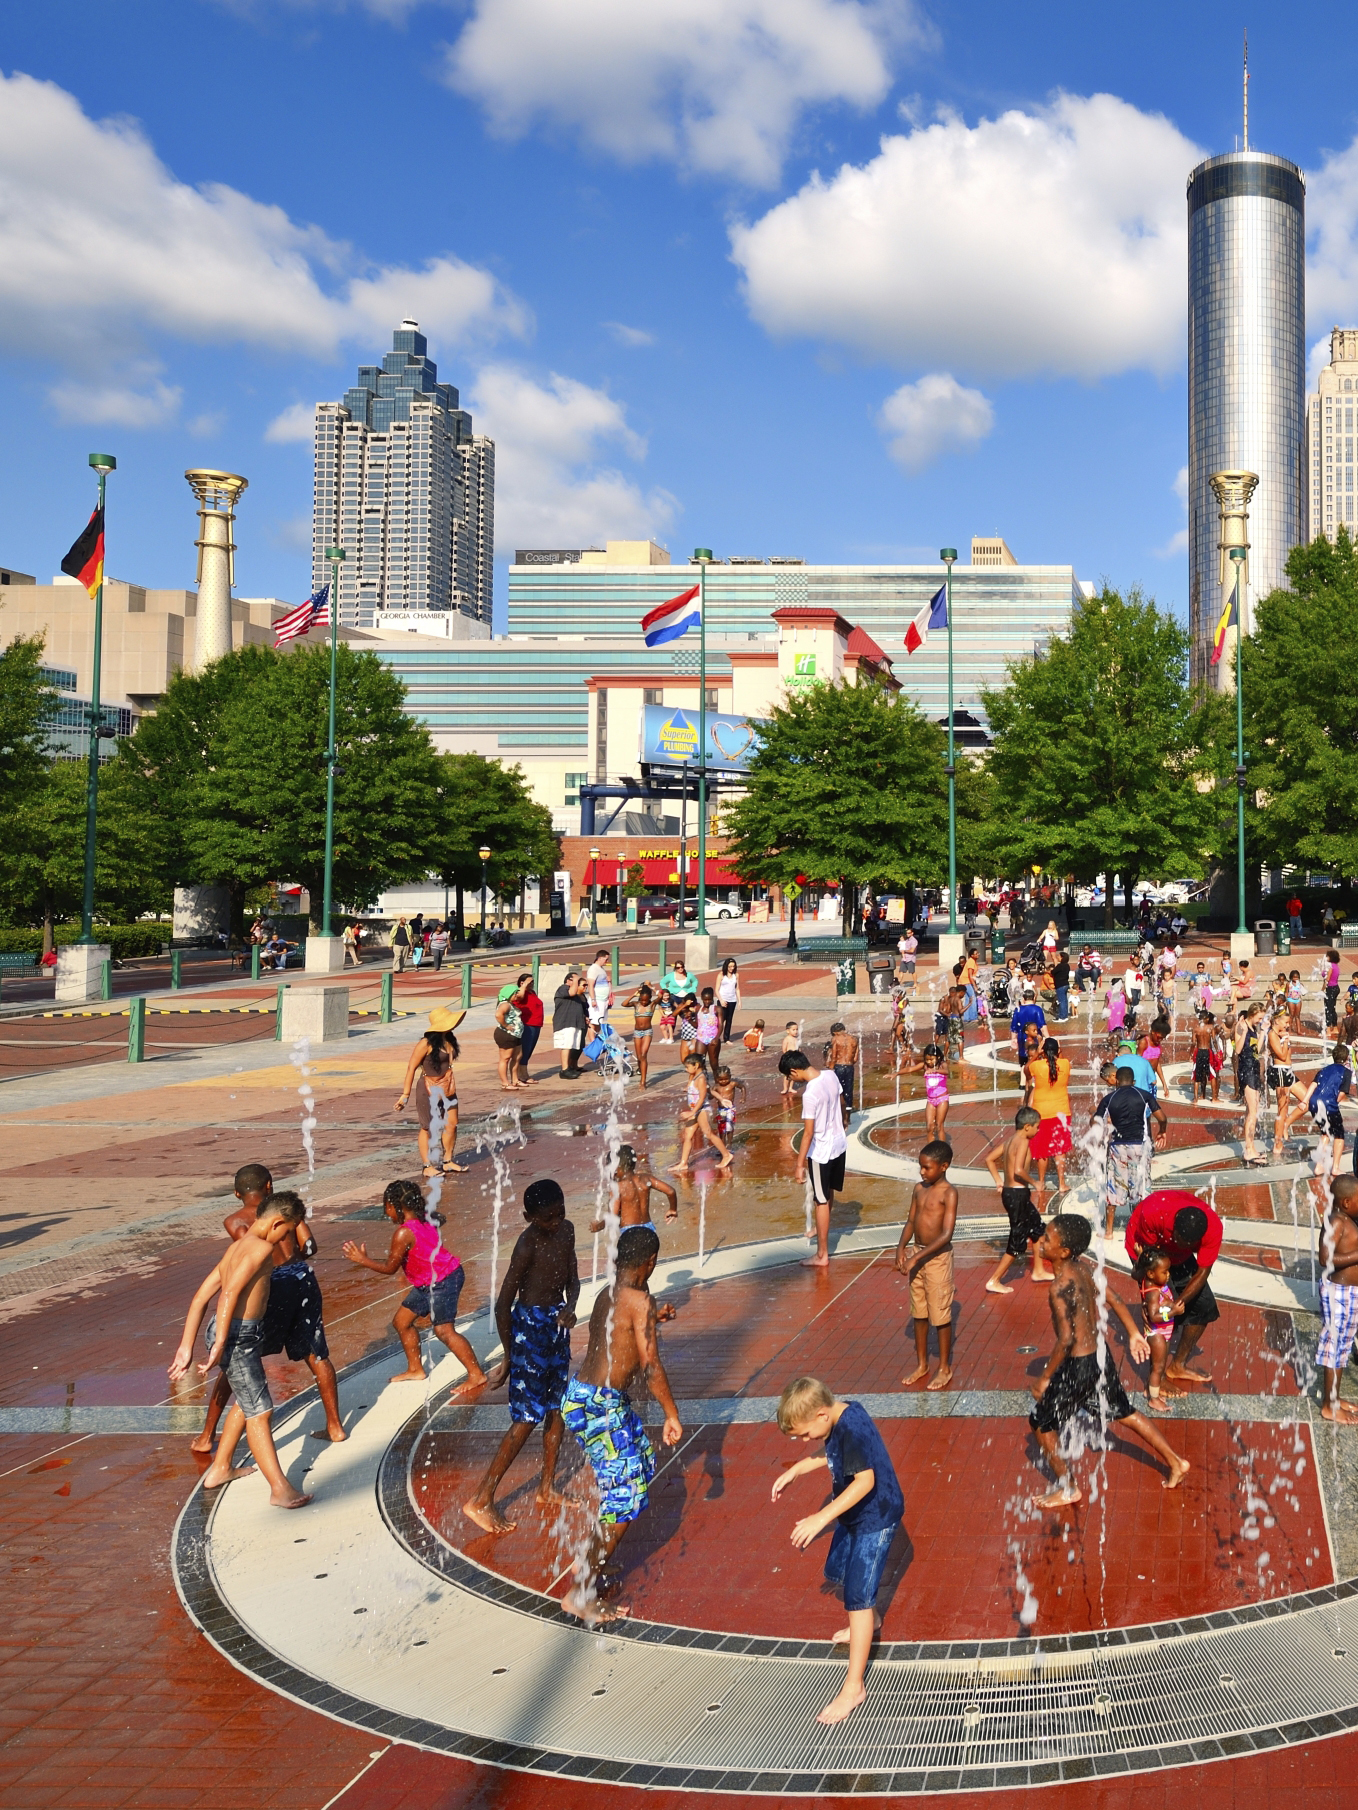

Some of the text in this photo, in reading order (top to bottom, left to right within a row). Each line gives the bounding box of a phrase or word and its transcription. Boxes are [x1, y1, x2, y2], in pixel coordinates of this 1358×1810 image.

[525, 552, 560, 562] Coastal
[380, 612, 446, 620] GEORGIA CHAMBER
[663, 728, 695, 741] Superior
[663, 741, 695, 753] PLUMBING
[638, 850, 719, 859] WAFFLE HOSE
